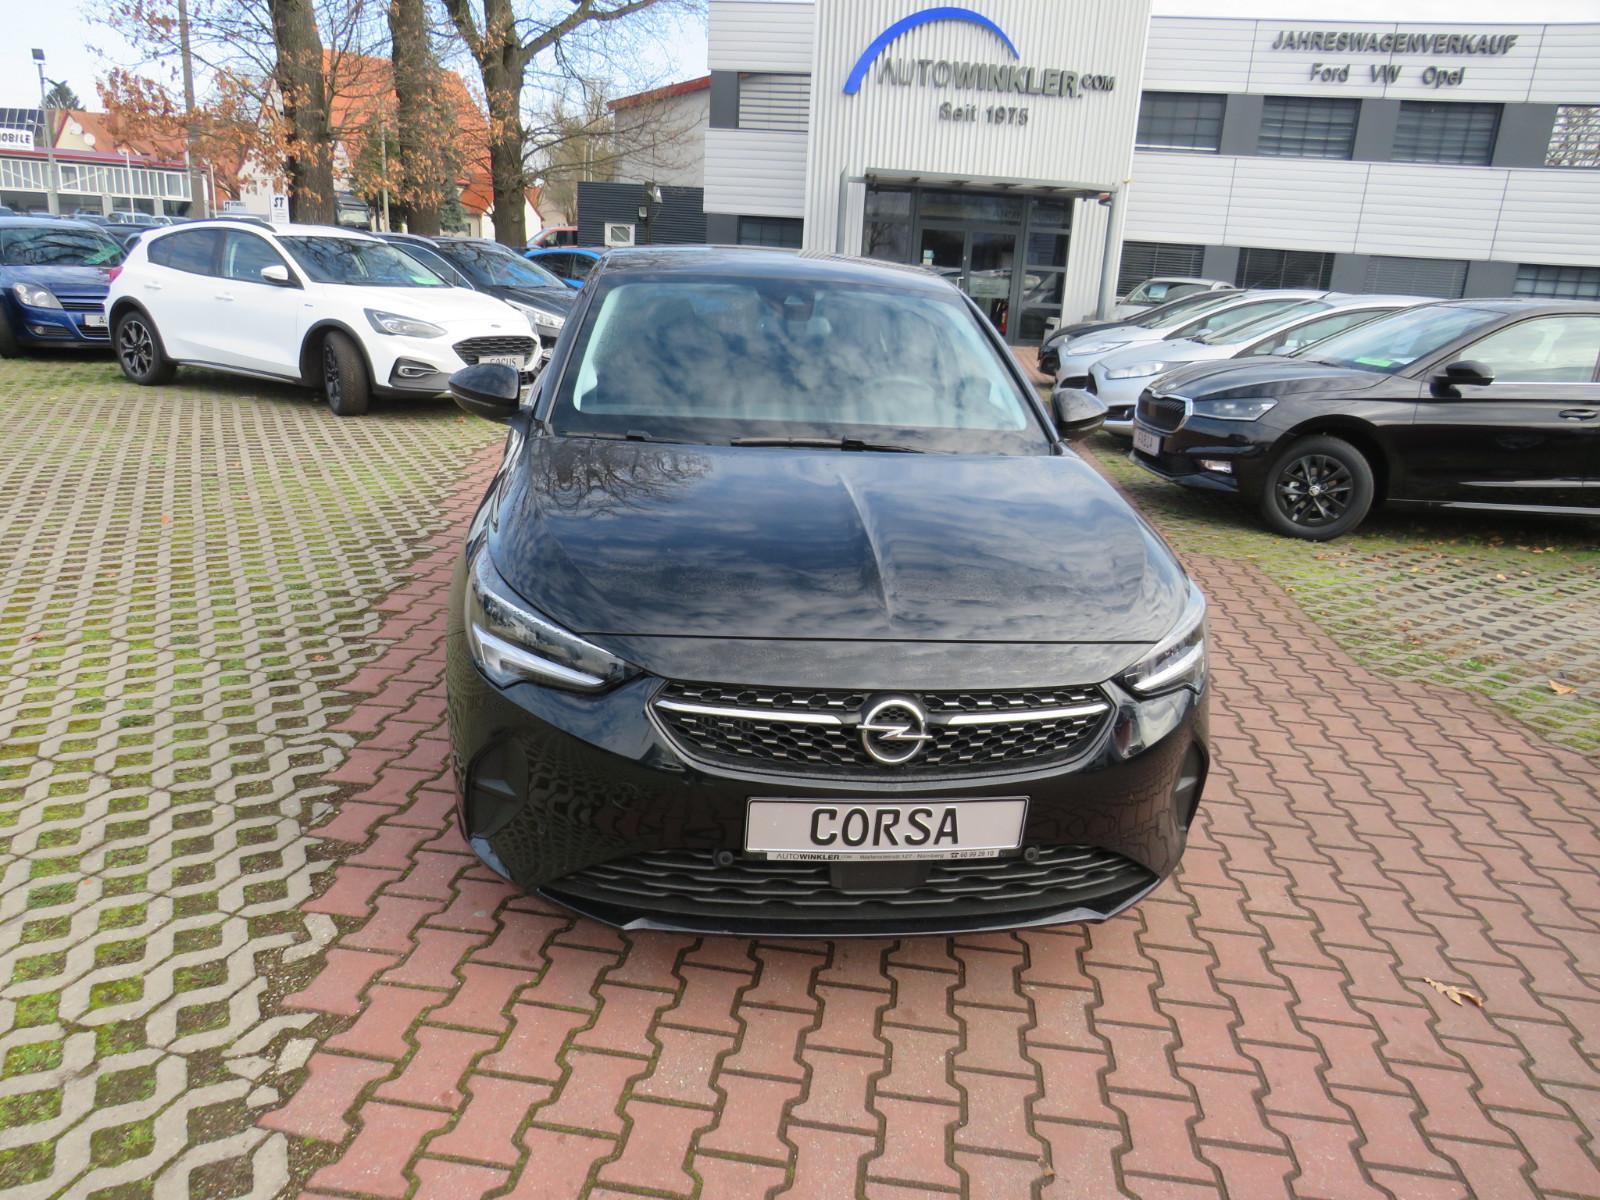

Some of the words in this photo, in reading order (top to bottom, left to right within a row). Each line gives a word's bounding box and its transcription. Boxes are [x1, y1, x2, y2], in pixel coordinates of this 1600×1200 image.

[1272, 30, 1518, 56] JAHRESWAGENVERKAUF
[1309, 62, 1350, 83] Ford
[1370, 64, 1402, 85] VW
[1421, 65, 1466, 89] Opel
[939, 101, 976, 122] Seit
[985, 105, 1028, 126] 1975
[0, 132, 31, 144] OBILE
[810, 807, 959, 847] CORSA
